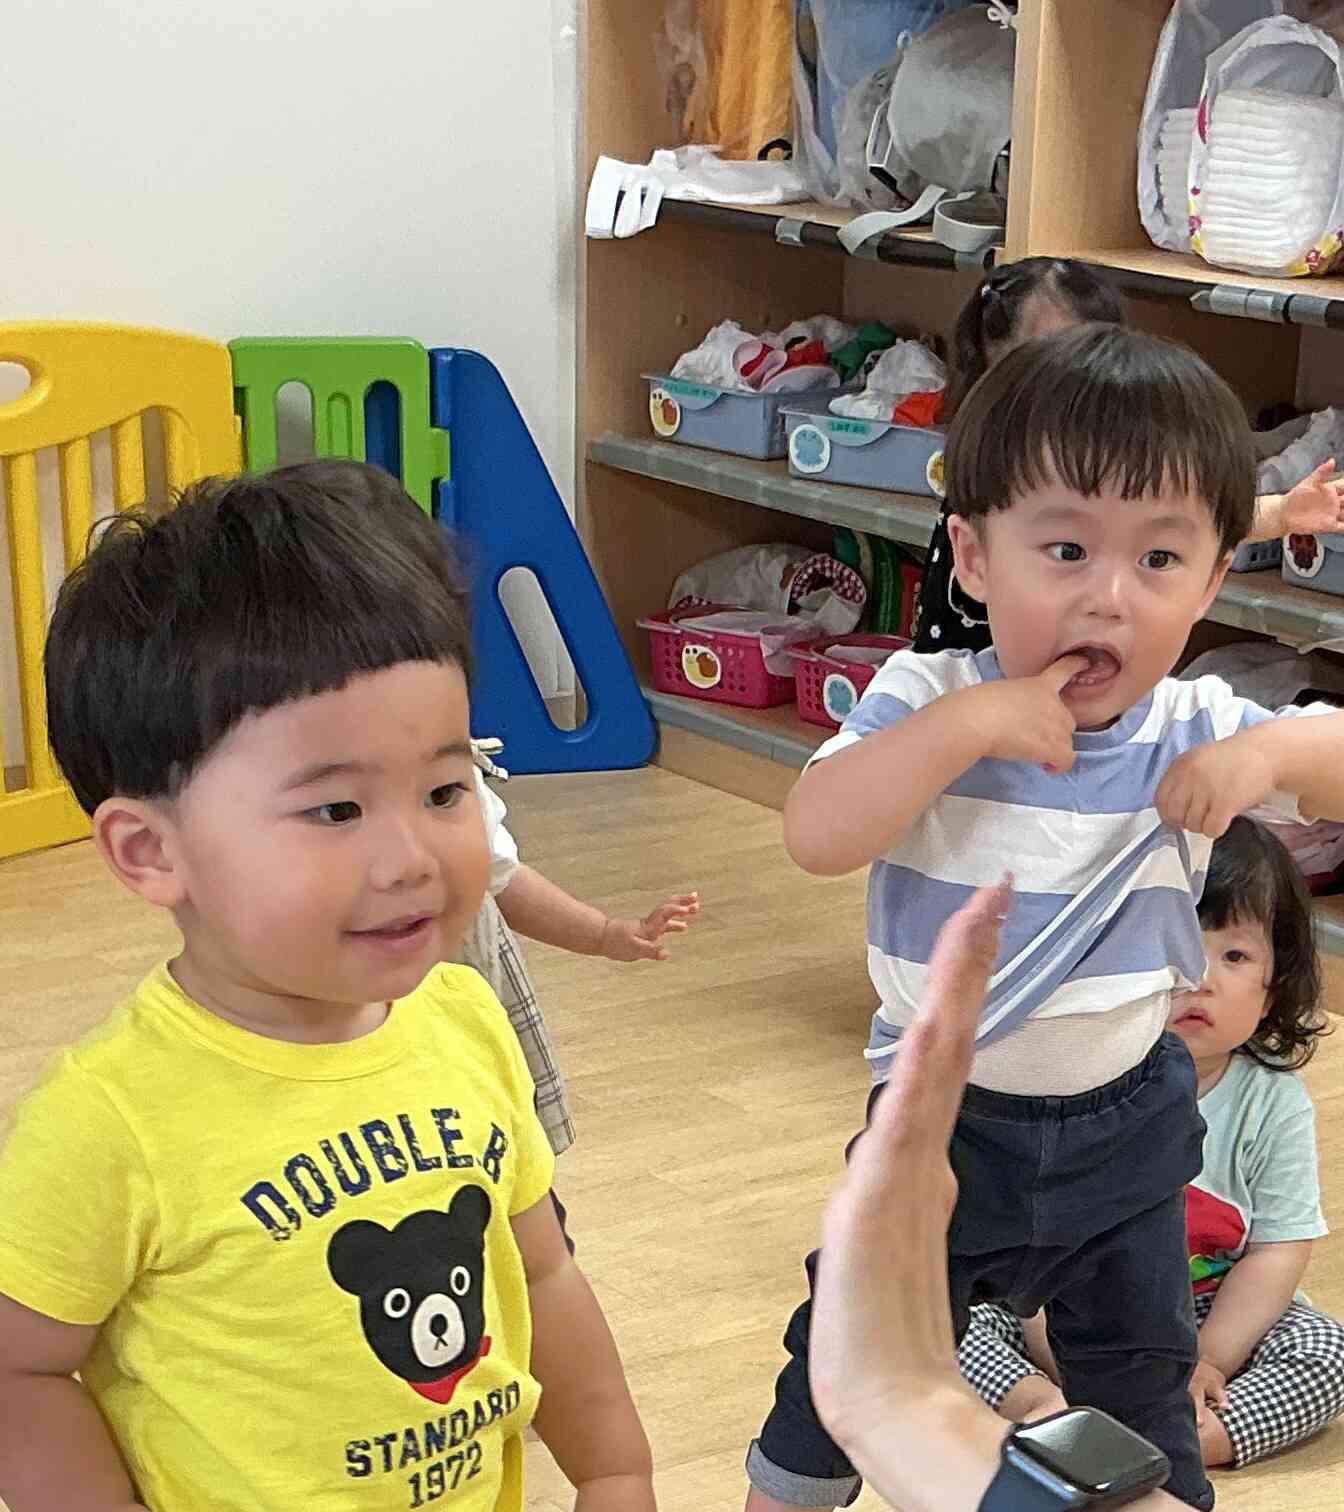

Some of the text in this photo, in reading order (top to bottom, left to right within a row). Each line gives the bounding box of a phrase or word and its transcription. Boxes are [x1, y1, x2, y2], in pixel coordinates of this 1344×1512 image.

[240, 1107, 474, 1242] DOUBLE
[344, 1380, 521, 1478] STANDARD
[407, 1441, 483, 1510] 1972
